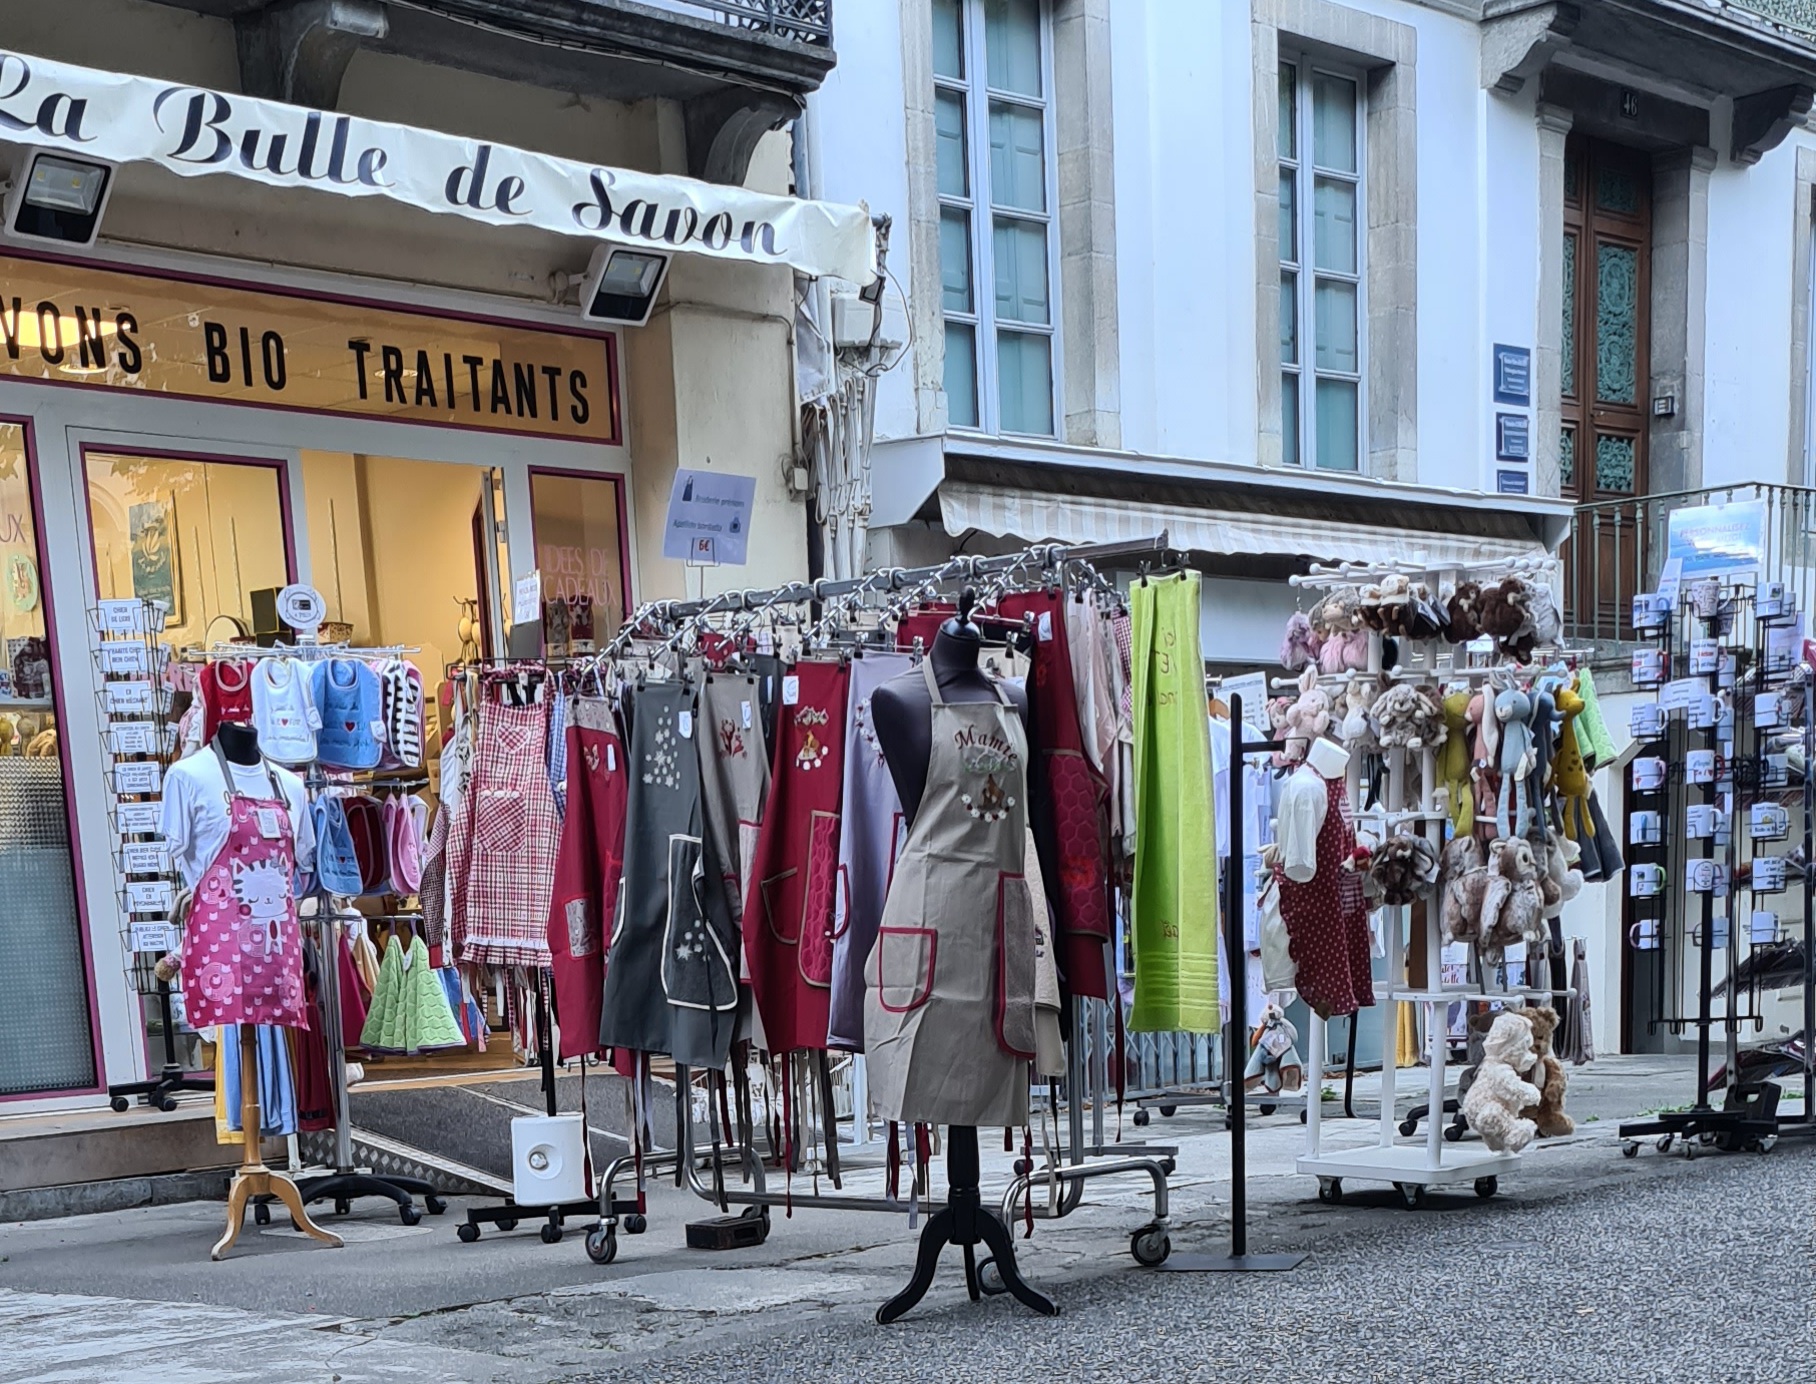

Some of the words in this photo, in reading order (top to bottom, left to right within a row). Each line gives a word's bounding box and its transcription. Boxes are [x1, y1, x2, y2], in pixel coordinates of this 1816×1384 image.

[1624, 93, 1638, 116] 46
[0, 53, 98, 142] La
[153, 86, 396, 188] Bulle
[445, 145, 533, 216] de
[572, 168, 788, 256] Savon
[0, 294, 142, 374] VONS
[204, 321, 287, 391] BIO
[348, 340, 590, 424] TRAITANTS
[543, 575, 618, 606] CADEAUX
[954, 724, 1018, 760] Mamie
